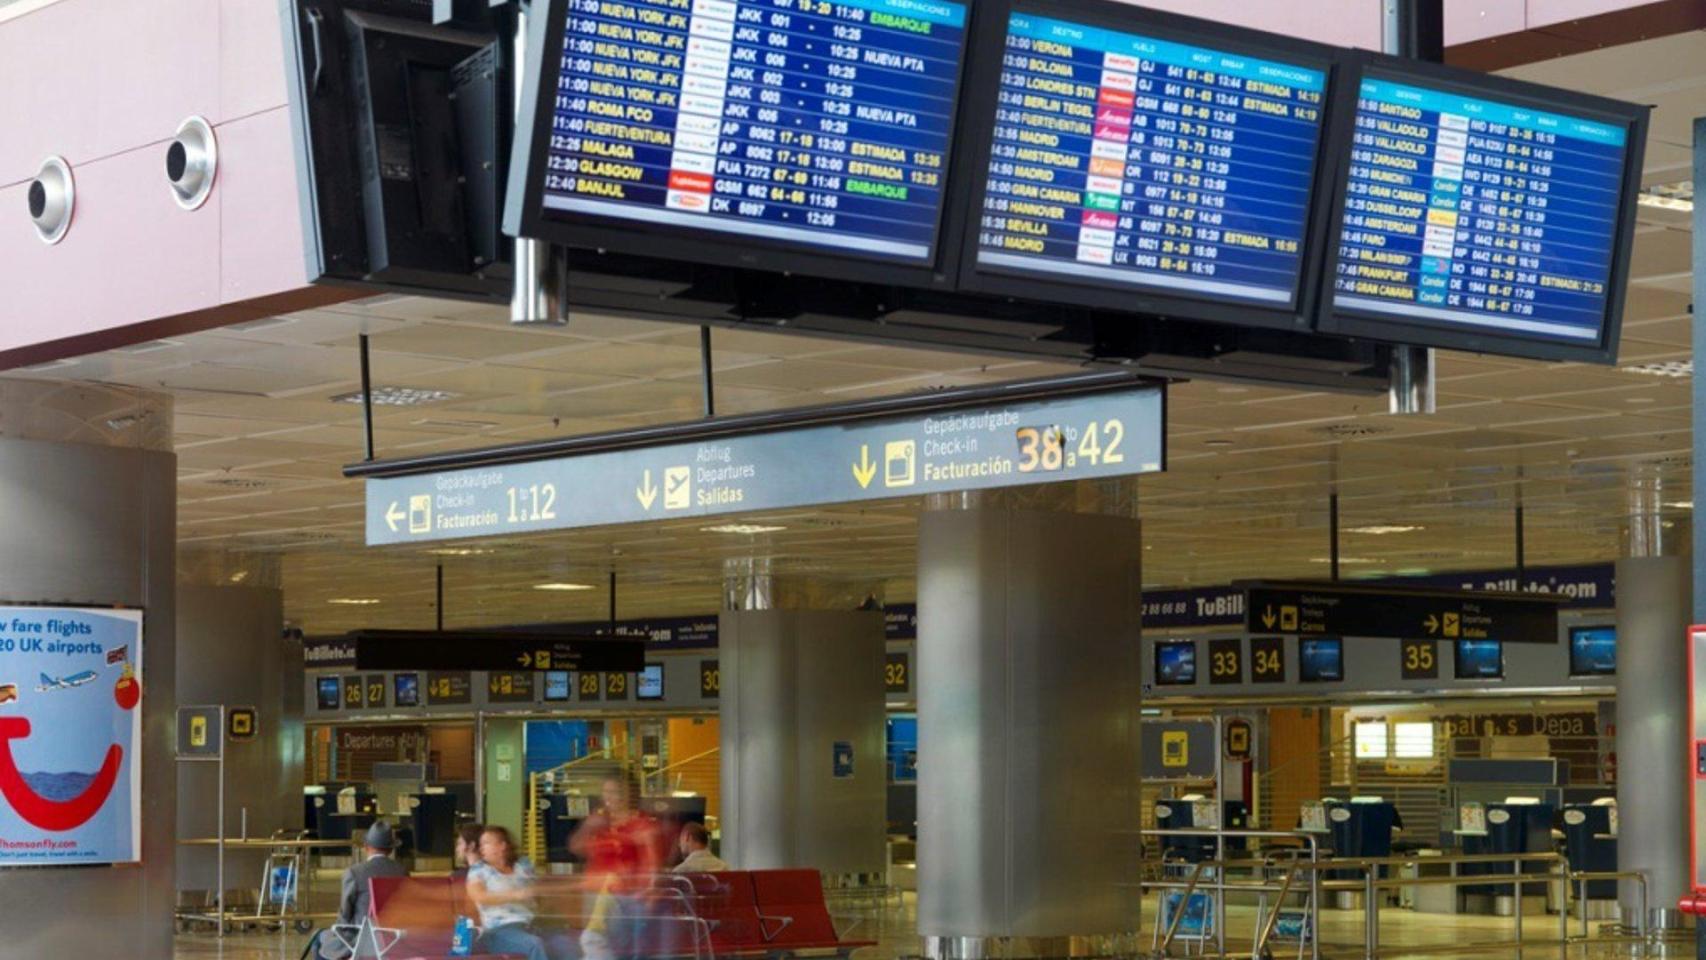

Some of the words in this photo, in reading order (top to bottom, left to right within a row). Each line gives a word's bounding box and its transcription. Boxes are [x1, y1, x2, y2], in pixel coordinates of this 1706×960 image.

[869, 11, 931, 33] EMBARQUE
[597, 23, 632, 40] NUEVA
[634, 29, 662, 44] YORK
[663, 35, 683, 48] JFK
[600, 2, 635, 19] NUEVA
[637, 9, 665, 24] YORK
[666, 14, 686, 28] JFK
[864, 50, 901, 67] NUEVA
[902, 56, 923, 71] PTA
[594, 42, 629, 59] NUEVA
[631, 48, 659, 64] YORK
[660, 54, 680, 67] JFK
[1032, 40, 1072, 57] VERONA
[1245, 80, 1290, 97] ESTIMADA
[589, 81, 624, 97] NUEVA
[627, 87, 654, 102] YORK
[655, 92, 675, 105] JFK
[592, 61, 627, 78] NUEVA
[630, 68, 657, 82] YORK
[658, 72, 678, 86] JFK
[856, 105, 893, 122] NUEVA
[895, 111, 916, 126] PTA
[1026, 77, 1074, 95] LONDRES
[1075, 85, 1095, 98] STN
[1028, 58, 1072, 76] BOLONIA
[1243, 97, 1287, 114] ESTIMADA
[1023, 95, 1060, 111] BERLIN
[1062, 101, 1094, 117] TEGEL
[1378, 103, 1420, 119] SANTIAGO
[587, 99, 624, 117] ROMA
[626, 106, 652, 121] FCO
[722, 121, 739, 134] AP
[850, 141, 905, 161] ESTIMADA
[1020, 112, 1091, 134] FUERTEVENTURA
[1376, 120, 1428, 138] VALLADOLID
[1019, 130, 1058, 146] MADRID
[1375, 137, 1426, 154] VALLADOLID
[584, 119, 670, 144] FUERTEVENTURA
[719, 141, 736, 153] AP
[848, 160, 903, 180] ESTIMADA
[1015, 148, 1079, 167] AMSTERDAM
[579, 159, 642, 179] GLASGOW
[582, 139, 633, 158] MALAGA
[845, 178, 907, 199] EMBARQUE
[1372, 152, 1417, 169] ZARAGOZA
[1014, 165, 1053, 181] MADRID
[576, 178, 624, 197] BANJUL
[1010, 183, 1039, 197] GRAN
[1038, 187, 1080, 203] CANARIA
[1391, 189, 1425, 202] CANARIA
[1006, 218, 1047, 234] SEVILLA
[1008, 201, 1064, 218] HANNOVER
[1223, 231, 1268, 247] ESTIMADA
[1003, 236, 1044, 252] MADRID
[1361, 233, 1385, 245] FARO
[1357, 265, 1408, 281] FRANKFURT
[1355, 281, 1378, 293] GRAN
[1378, 284, 1413, 298] CANARIA
[924, 410, 1020, 434] Gepäckaufgabe
[697, 446, 731, 463] Abflug
[923, 457, 1013, 482] Facturación
[1017, 425, 1063, 473] 38
[1067, 453, 1077, 467] a
[1078, 418, 1126, 466] 42
[924, 437, 978, 457] Check-in
[697, 464, 755, 485] Departures
[436, 494, 474, 509] Check-in
[437, 509, 498, 529] Facturación
[506, 486, 518, 523] 1
[530, 483, 556, 520] 12
[697, 486, 743, 506] Salidas
[12, 618, 42, 632] fare
[47, 618, 92, 637] flights
[20, 638, 43, 652] UK
[47, 640, 103, 655] airports
[1213, 651, 1237, 675] 33
[1255, 649, 1281, 674] 34
[1405, 645, 1433, 670] 35
[581, 674, 598, 694] 28
[608, 674, 625, 694] 29
[703, 670, 719, 691] 30
[885, 663, 905, 686] 32
[347, 685, 361, 703] 26
[367, 683, 383, 702] 27
